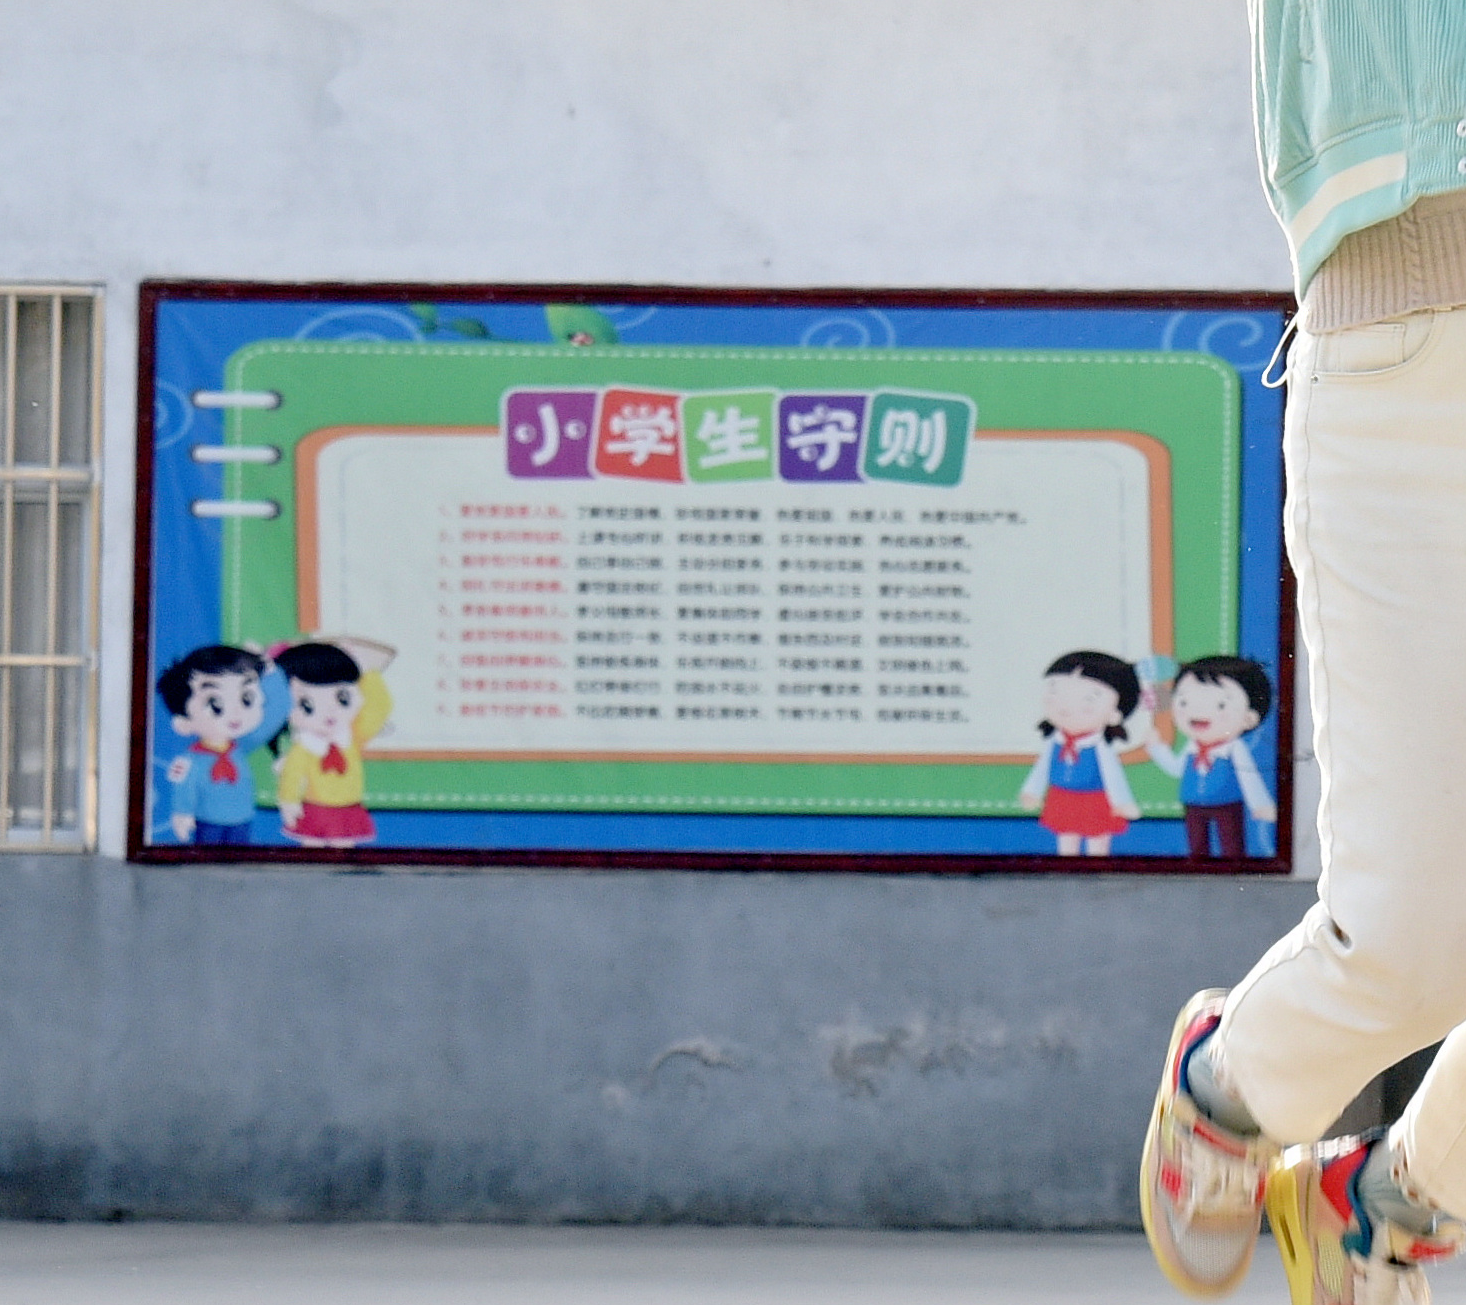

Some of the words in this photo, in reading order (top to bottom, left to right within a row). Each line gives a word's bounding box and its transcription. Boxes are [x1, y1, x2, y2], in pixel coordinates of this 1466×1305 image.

[514, 401, 948, 473] 小学生守则
